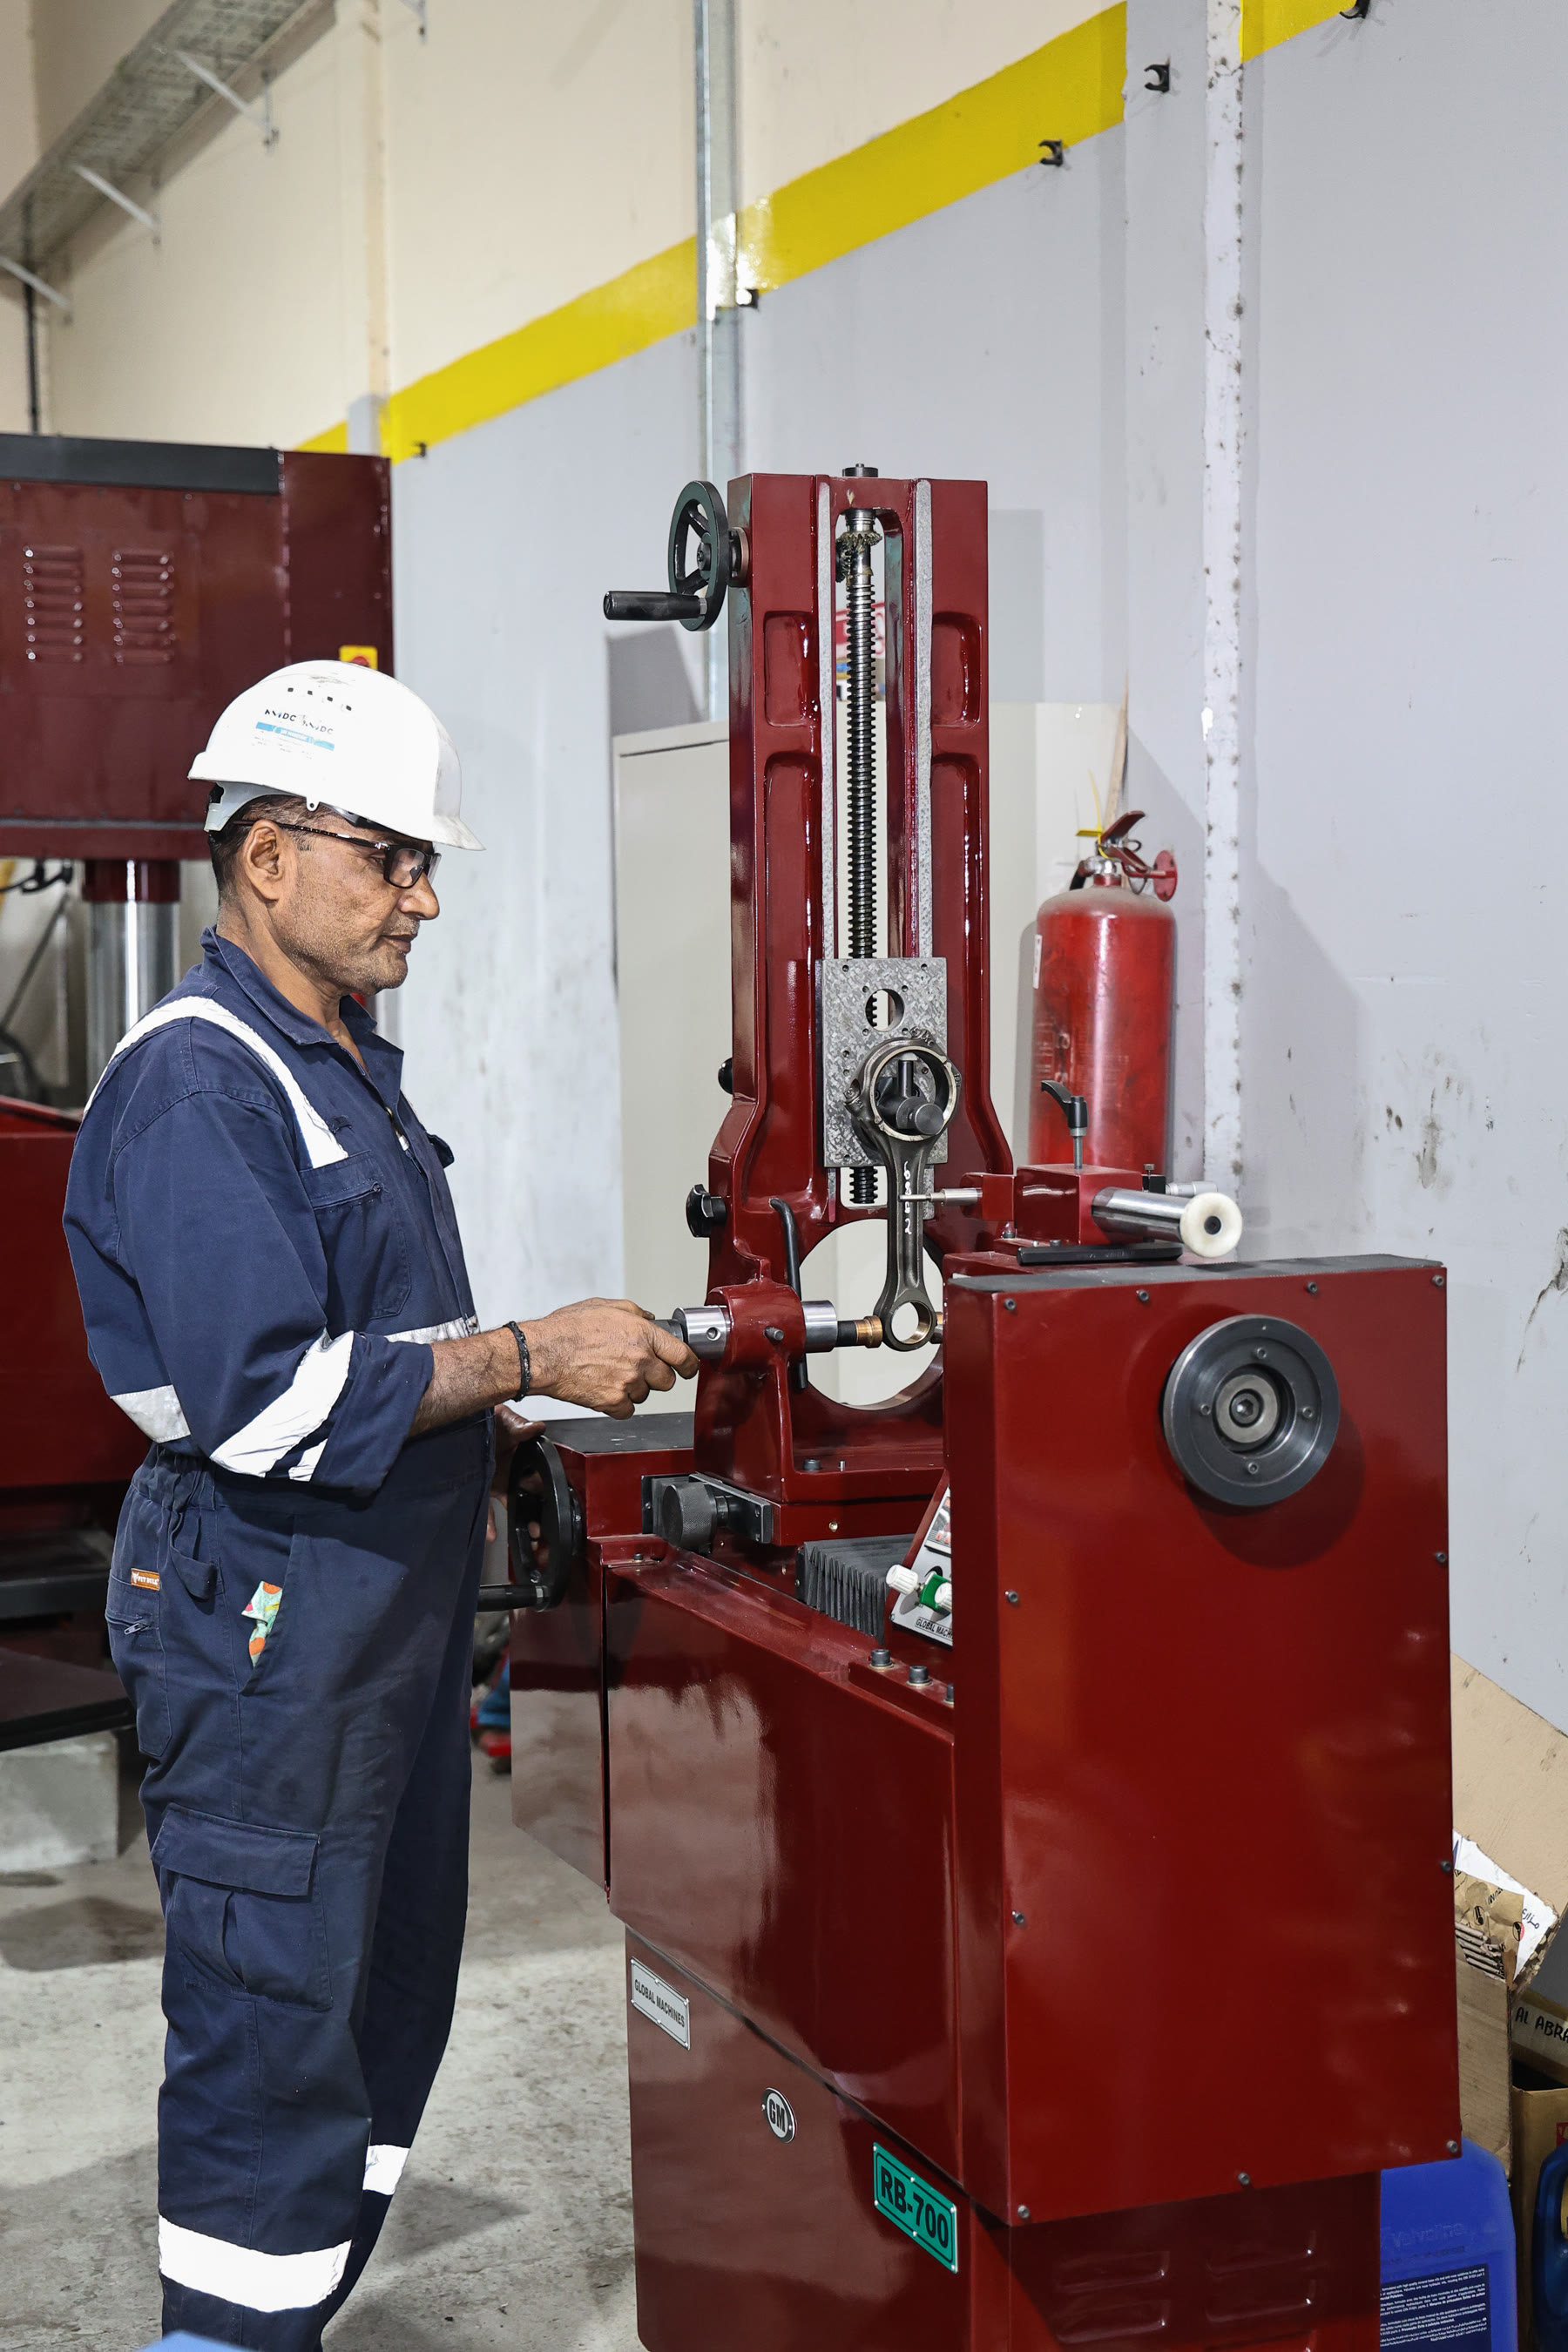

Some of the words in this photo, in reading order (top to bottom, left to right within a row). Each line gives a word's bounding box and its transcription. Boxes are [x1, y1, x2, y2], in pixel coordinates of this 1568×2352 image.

[916, 1618, 936, 1632] GLOBAL
[634, 1978, 656, 2004] GLOBAL
[656, 1994, 686, 2028] MACHINES
[1515, 2006, 1529, 2024] AL
[768, 2098, 786, 2133] GM
[881, 2165, 950, 2249] RB-700
